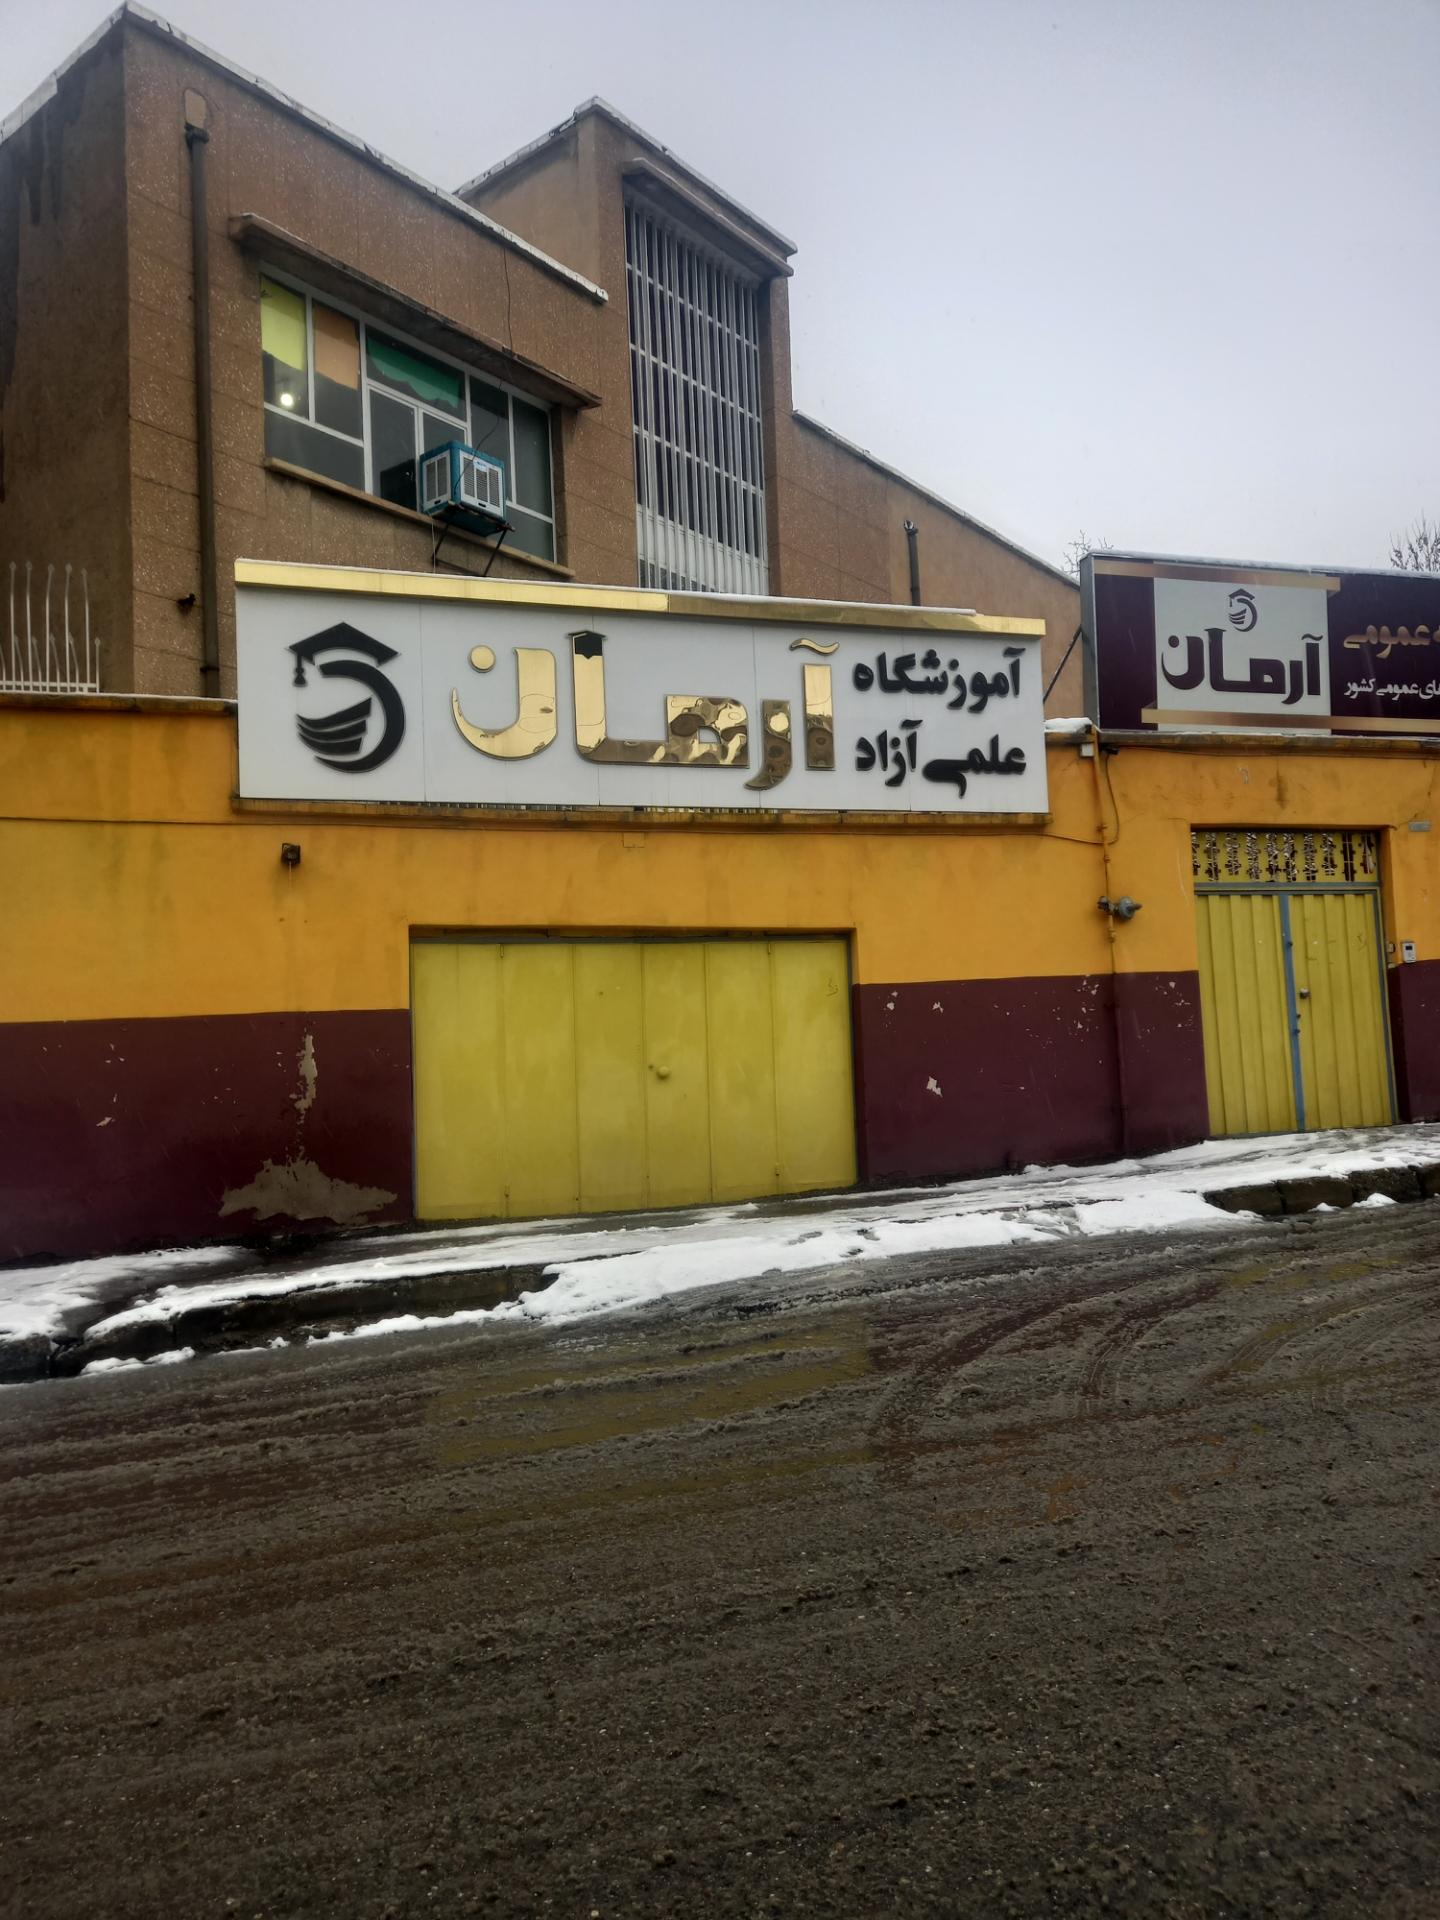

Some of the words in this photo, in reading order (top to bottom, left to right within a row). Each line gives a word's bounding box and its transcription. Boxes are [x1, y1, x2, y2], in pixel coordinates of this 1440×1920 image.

[1161, 627, 1323, 704] آرمان
[1343, 624, 1432, 658] عمومی
[452, 630, 840, 791] آرمان
[853, 648, 1026, 713] آموزشگاه
[1343, 678, 1376, 699] کشور
[1375, 683, 1419, 701] عمومی
[855, 718, 923, 787] آزاد
[922, 733, 1027, 799] علمی
